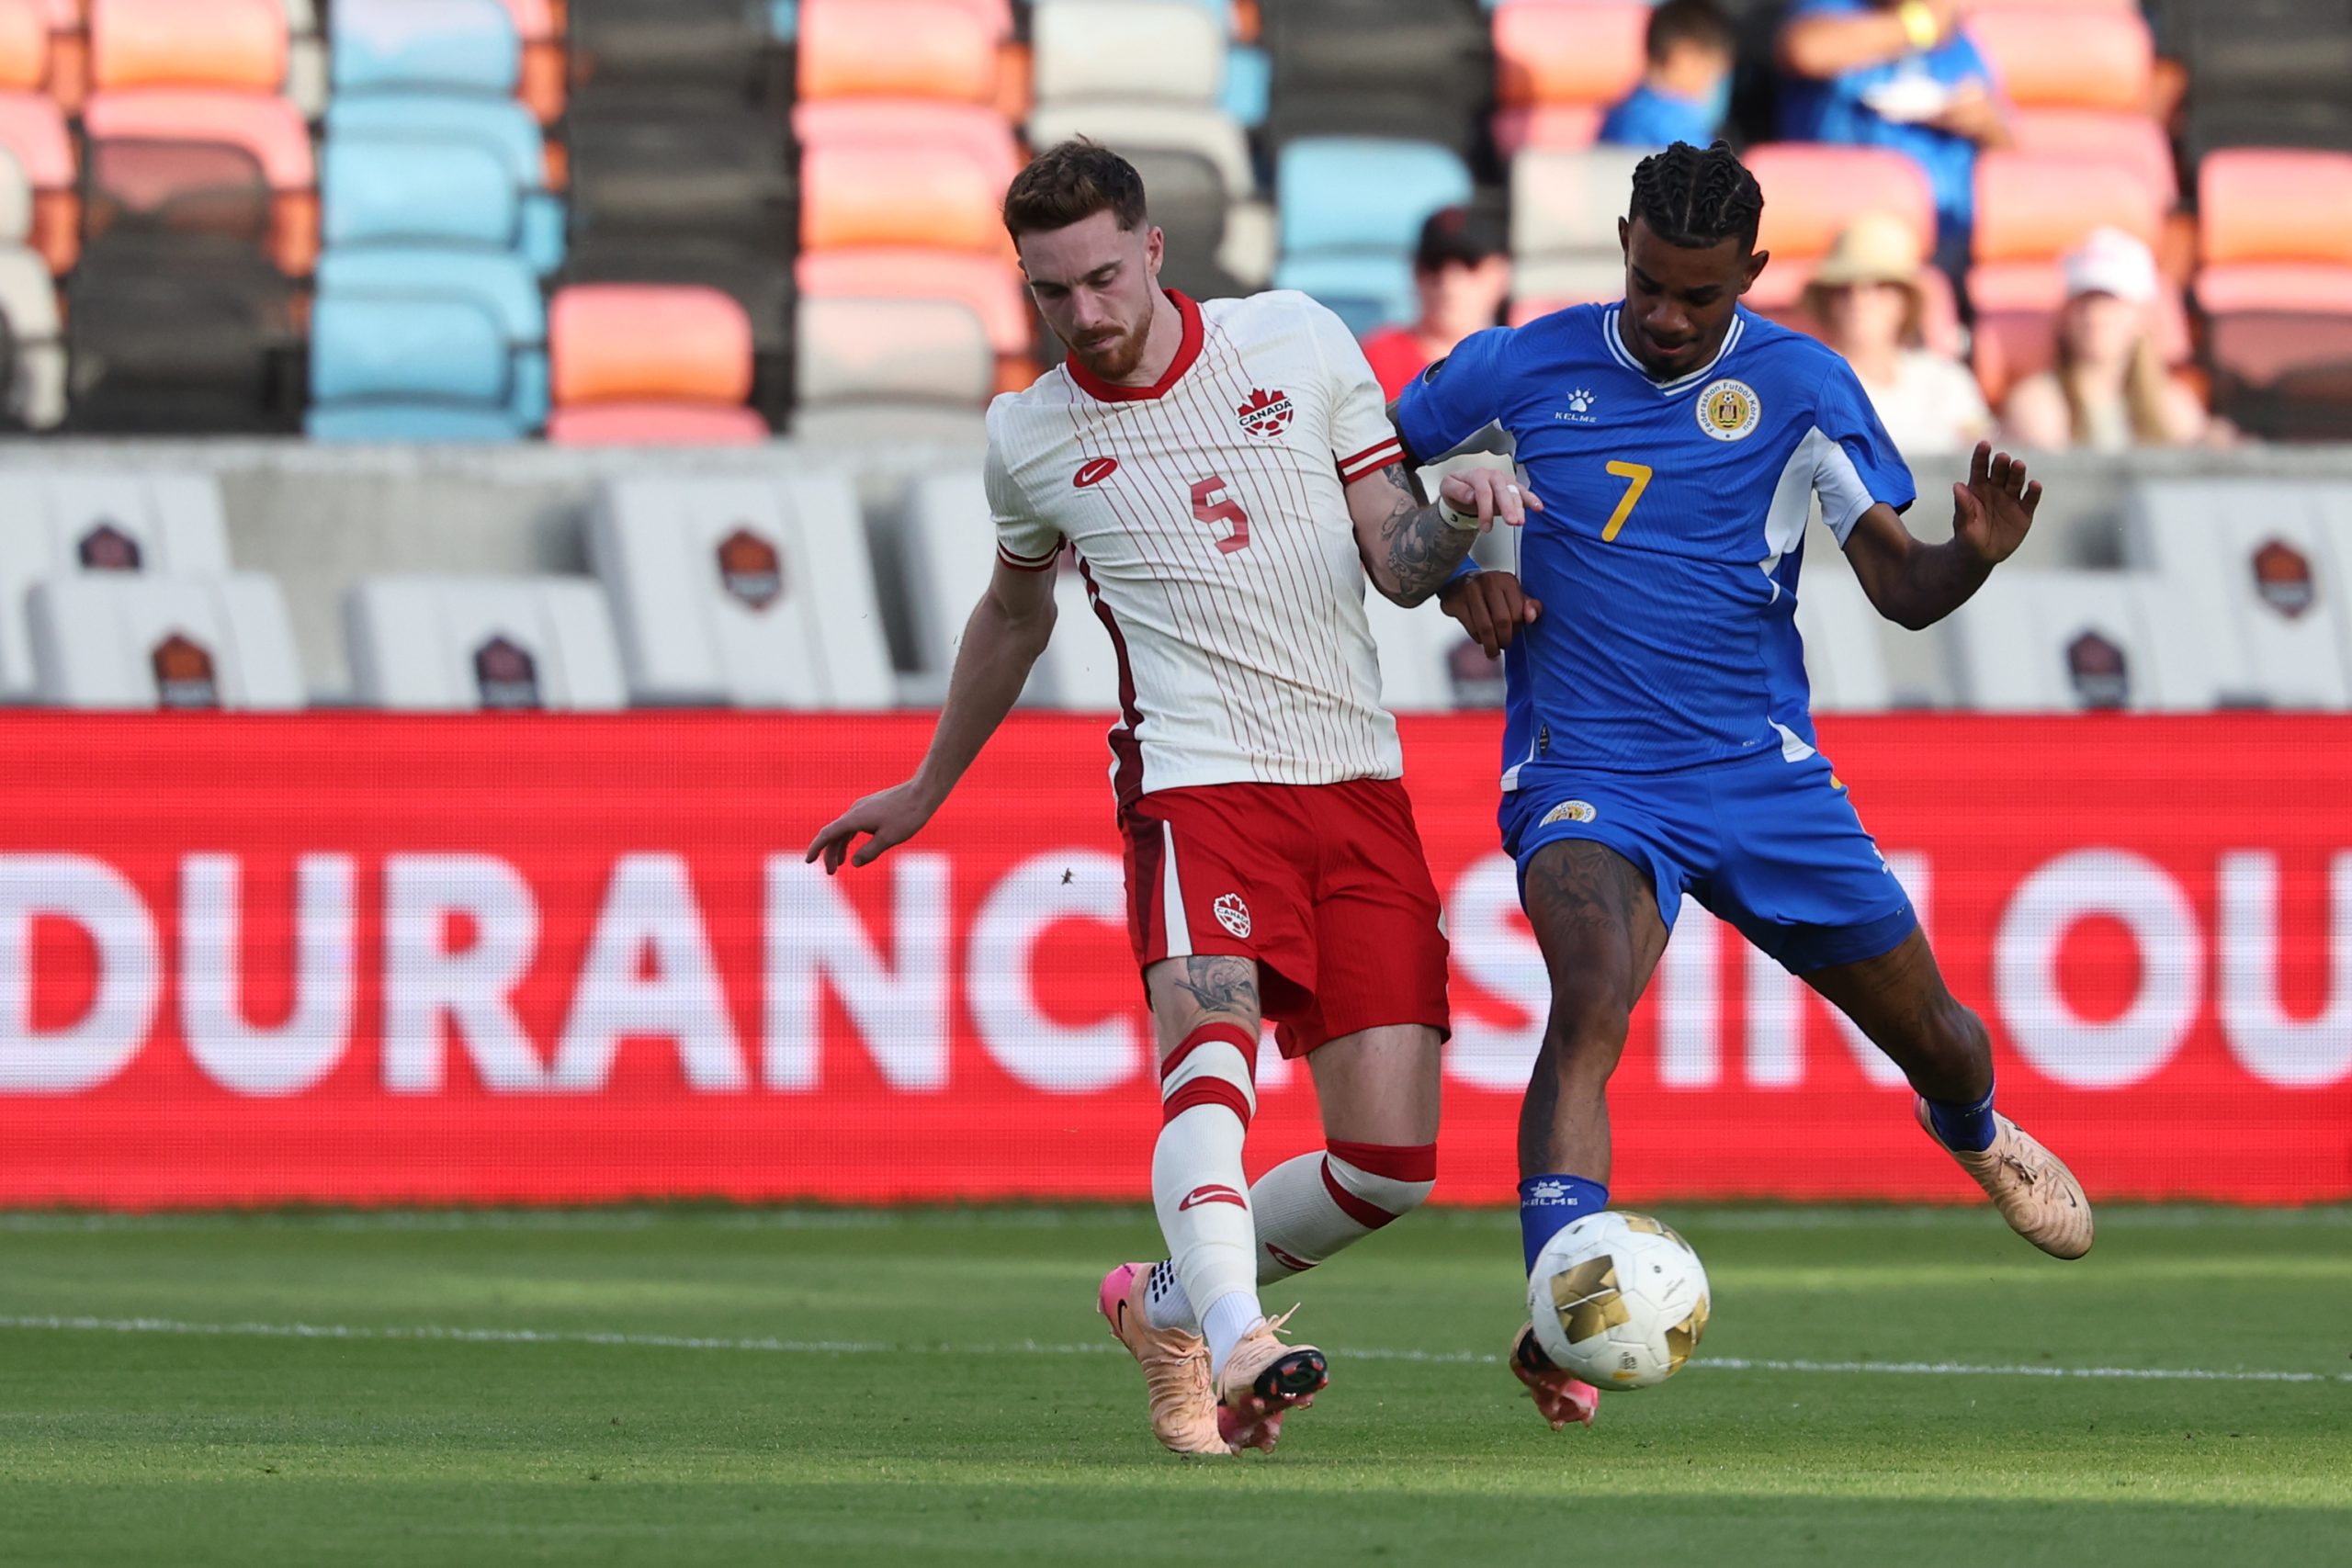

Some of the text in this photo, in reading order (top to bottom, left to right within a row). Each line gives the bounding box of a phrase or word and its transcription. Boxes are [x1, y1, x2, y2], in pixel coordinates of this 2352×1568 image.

[1238, 400, 1294, 426] CANADA
[1555, 412, 1597, 423] KELME
[1190, 474, 1250, 555] 5
[1601, 460, 1653, 542] 7
[0, 851, 1294, 1095] DURANC
[1989, 847, 2352, 1090] OU
[1521, 1197, 1578, 1208] KELME
